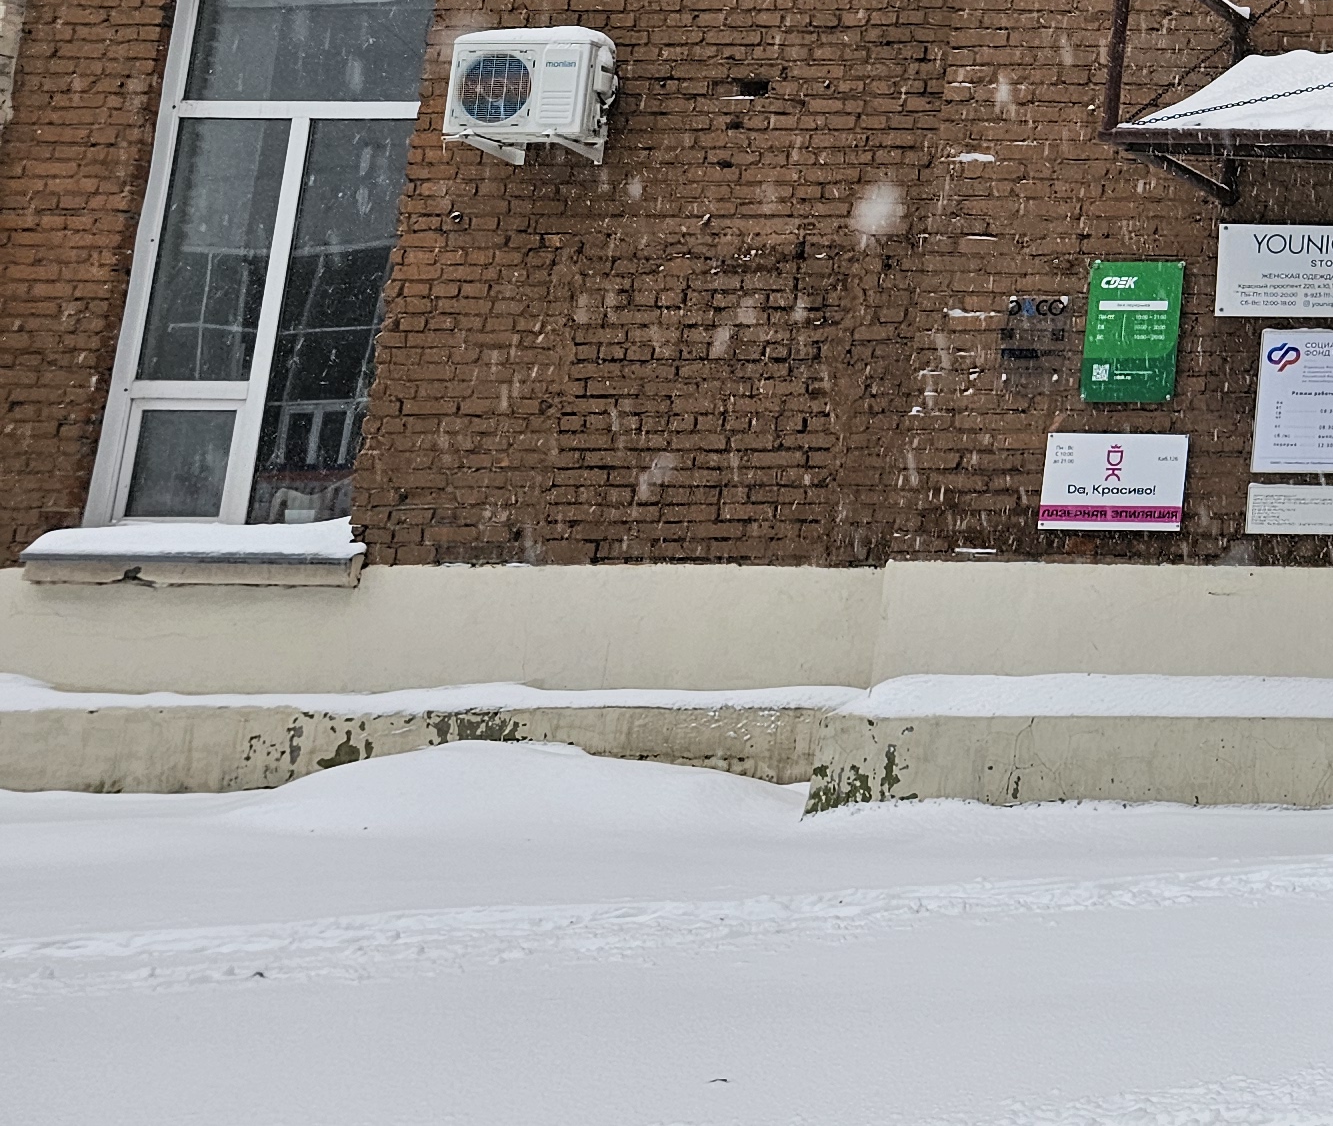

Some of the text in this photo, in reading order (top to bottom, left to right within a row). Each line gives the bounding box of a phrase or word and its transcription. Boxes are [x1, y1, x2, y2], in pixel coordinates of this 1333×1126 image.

[1101, 276, 1138, 288] CDEK
[1304, 349, 1331, 357] ФОНД
[1092, 484, 1156, 497] Красиво!
[1041, 509, 1179, 520] ЛАЗЕРНАЯ ЭПИЛЯЦИЯ
